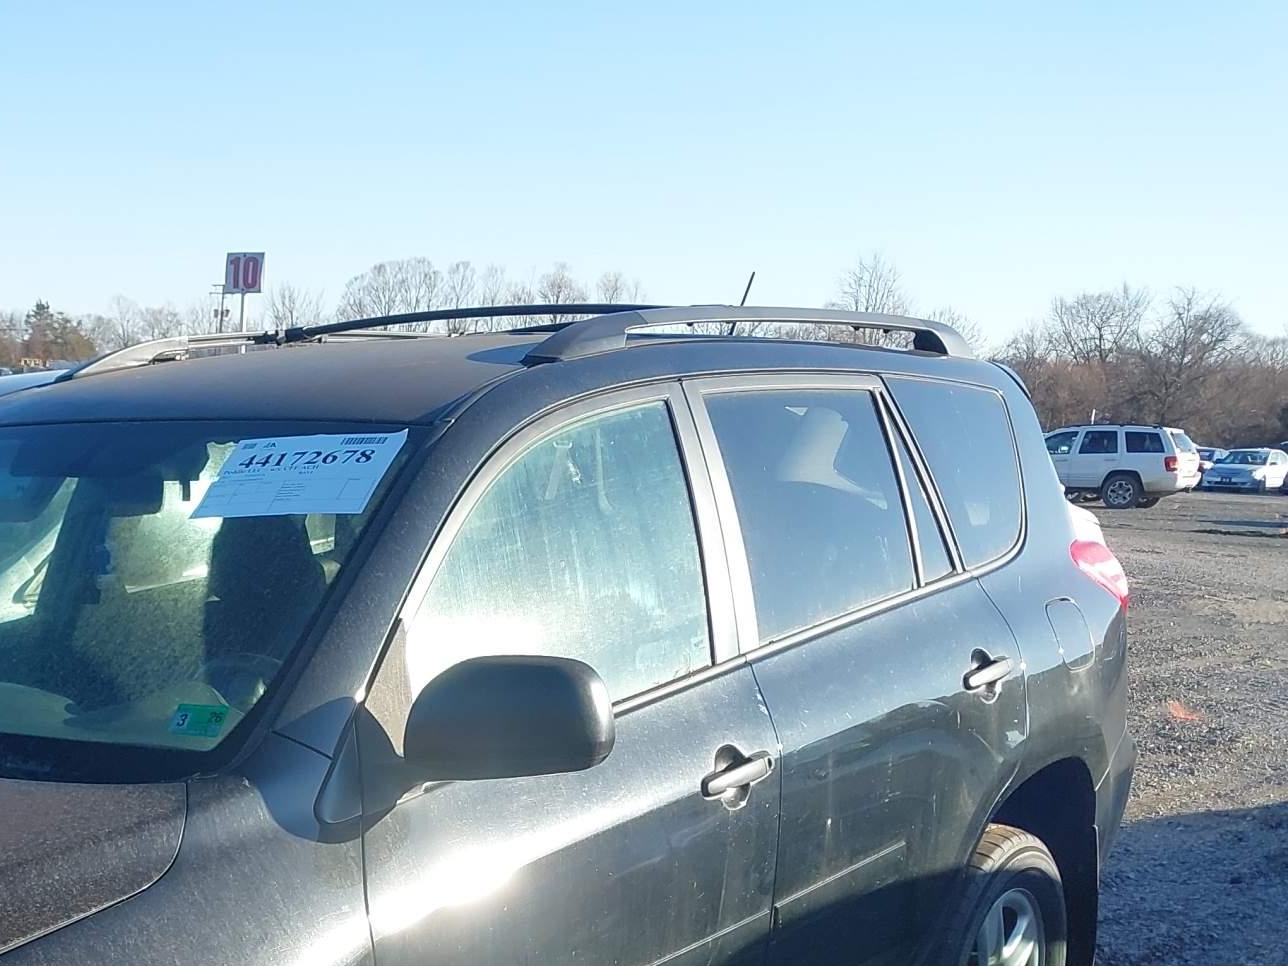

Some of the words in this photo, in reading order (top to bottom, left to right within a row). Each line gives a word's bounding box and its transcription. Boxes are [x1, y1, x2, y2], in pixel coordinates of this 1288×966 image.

[230, 256, 259, 289] 10
[238, 449, 376, 468] 44172678
[175, 713, 189, 727] 3
